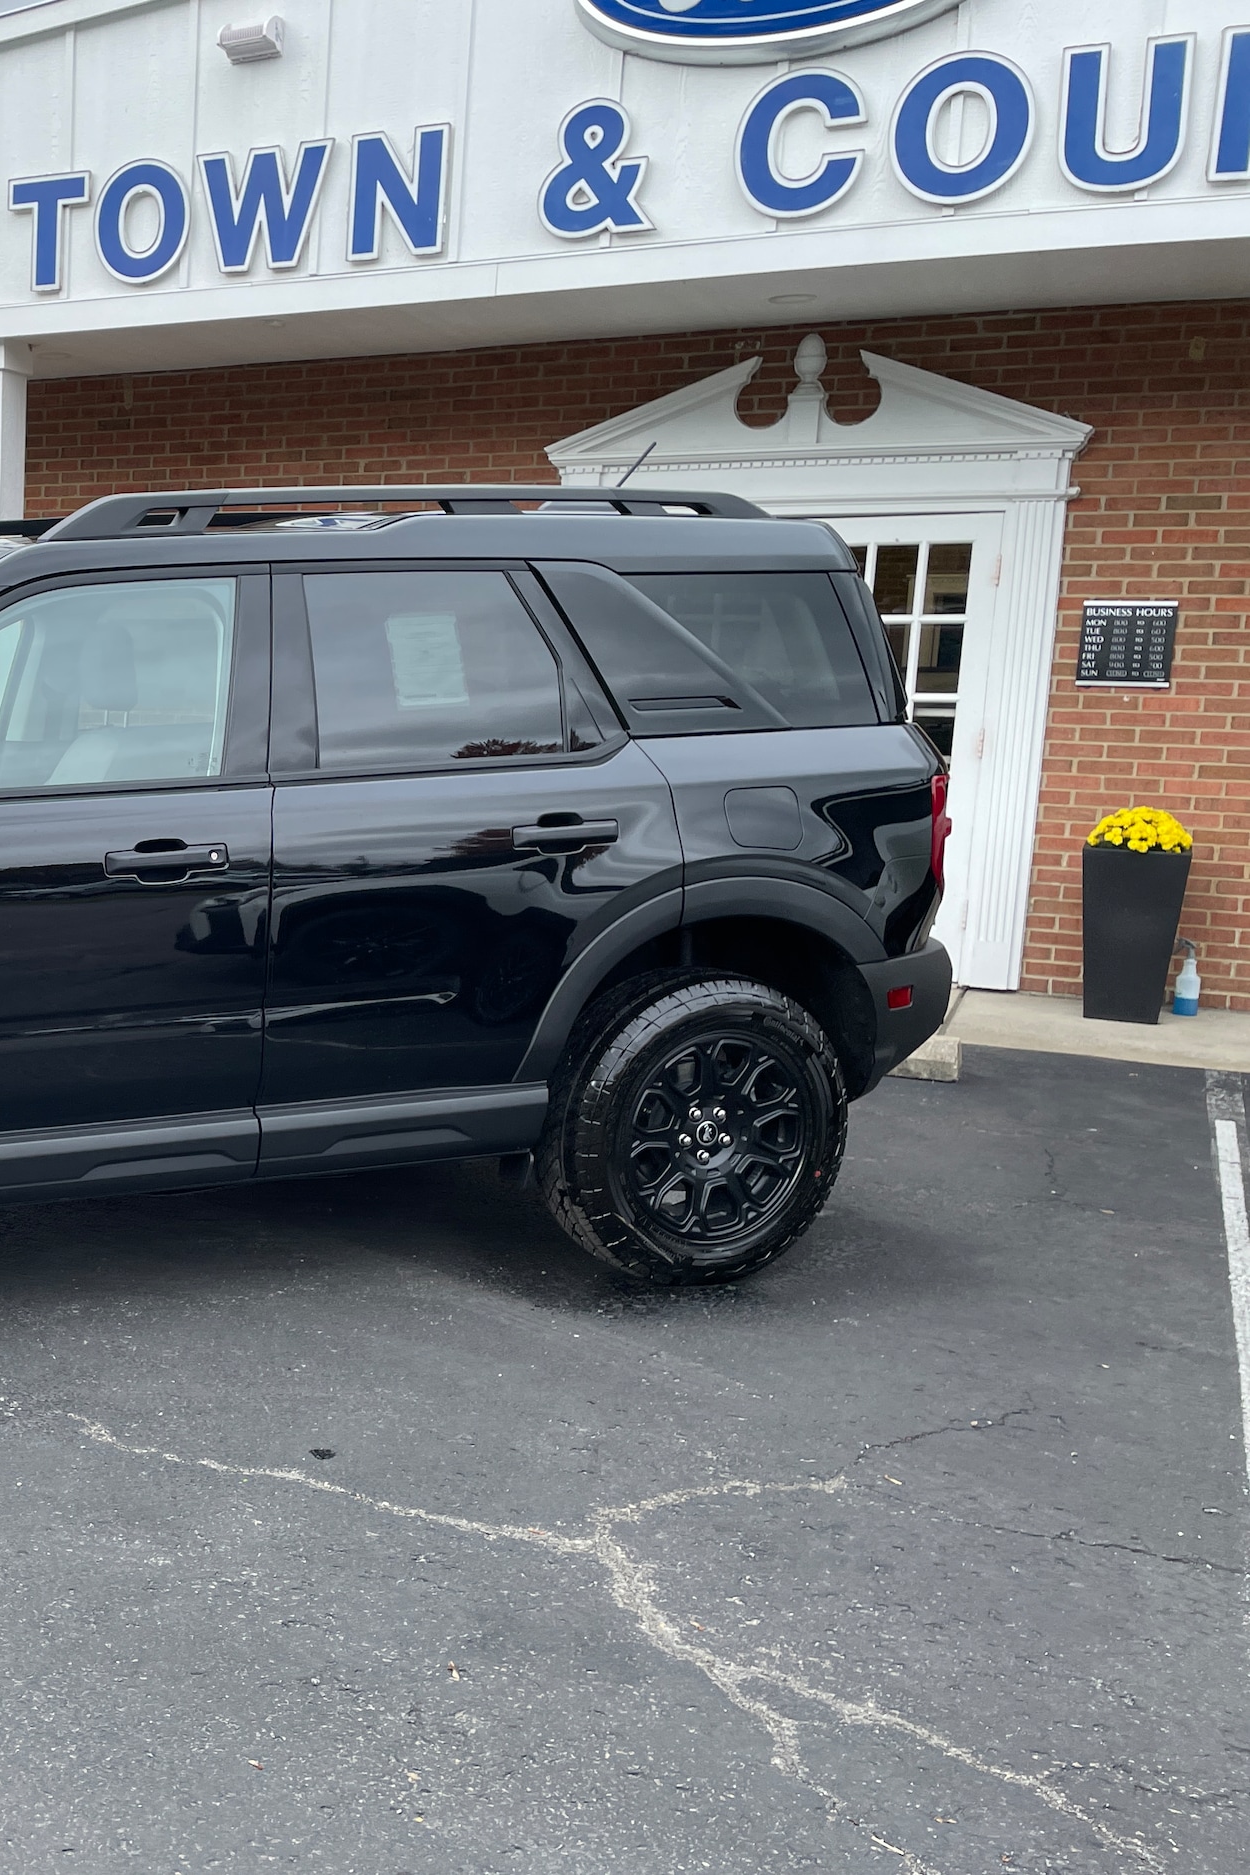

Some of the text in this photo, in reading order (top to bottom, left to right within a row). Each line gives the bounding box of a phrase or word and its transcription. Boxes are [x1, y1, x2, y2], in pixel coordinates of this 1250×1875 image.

[9, 124, 449, 291] TOWN
[540, 97, 655, 239] &
[1086, 607, 1173, 617] BUSINESS HOURS
[1086, 627, 1101, 635] TUE
[1084, 644, 1102, 652] THU
